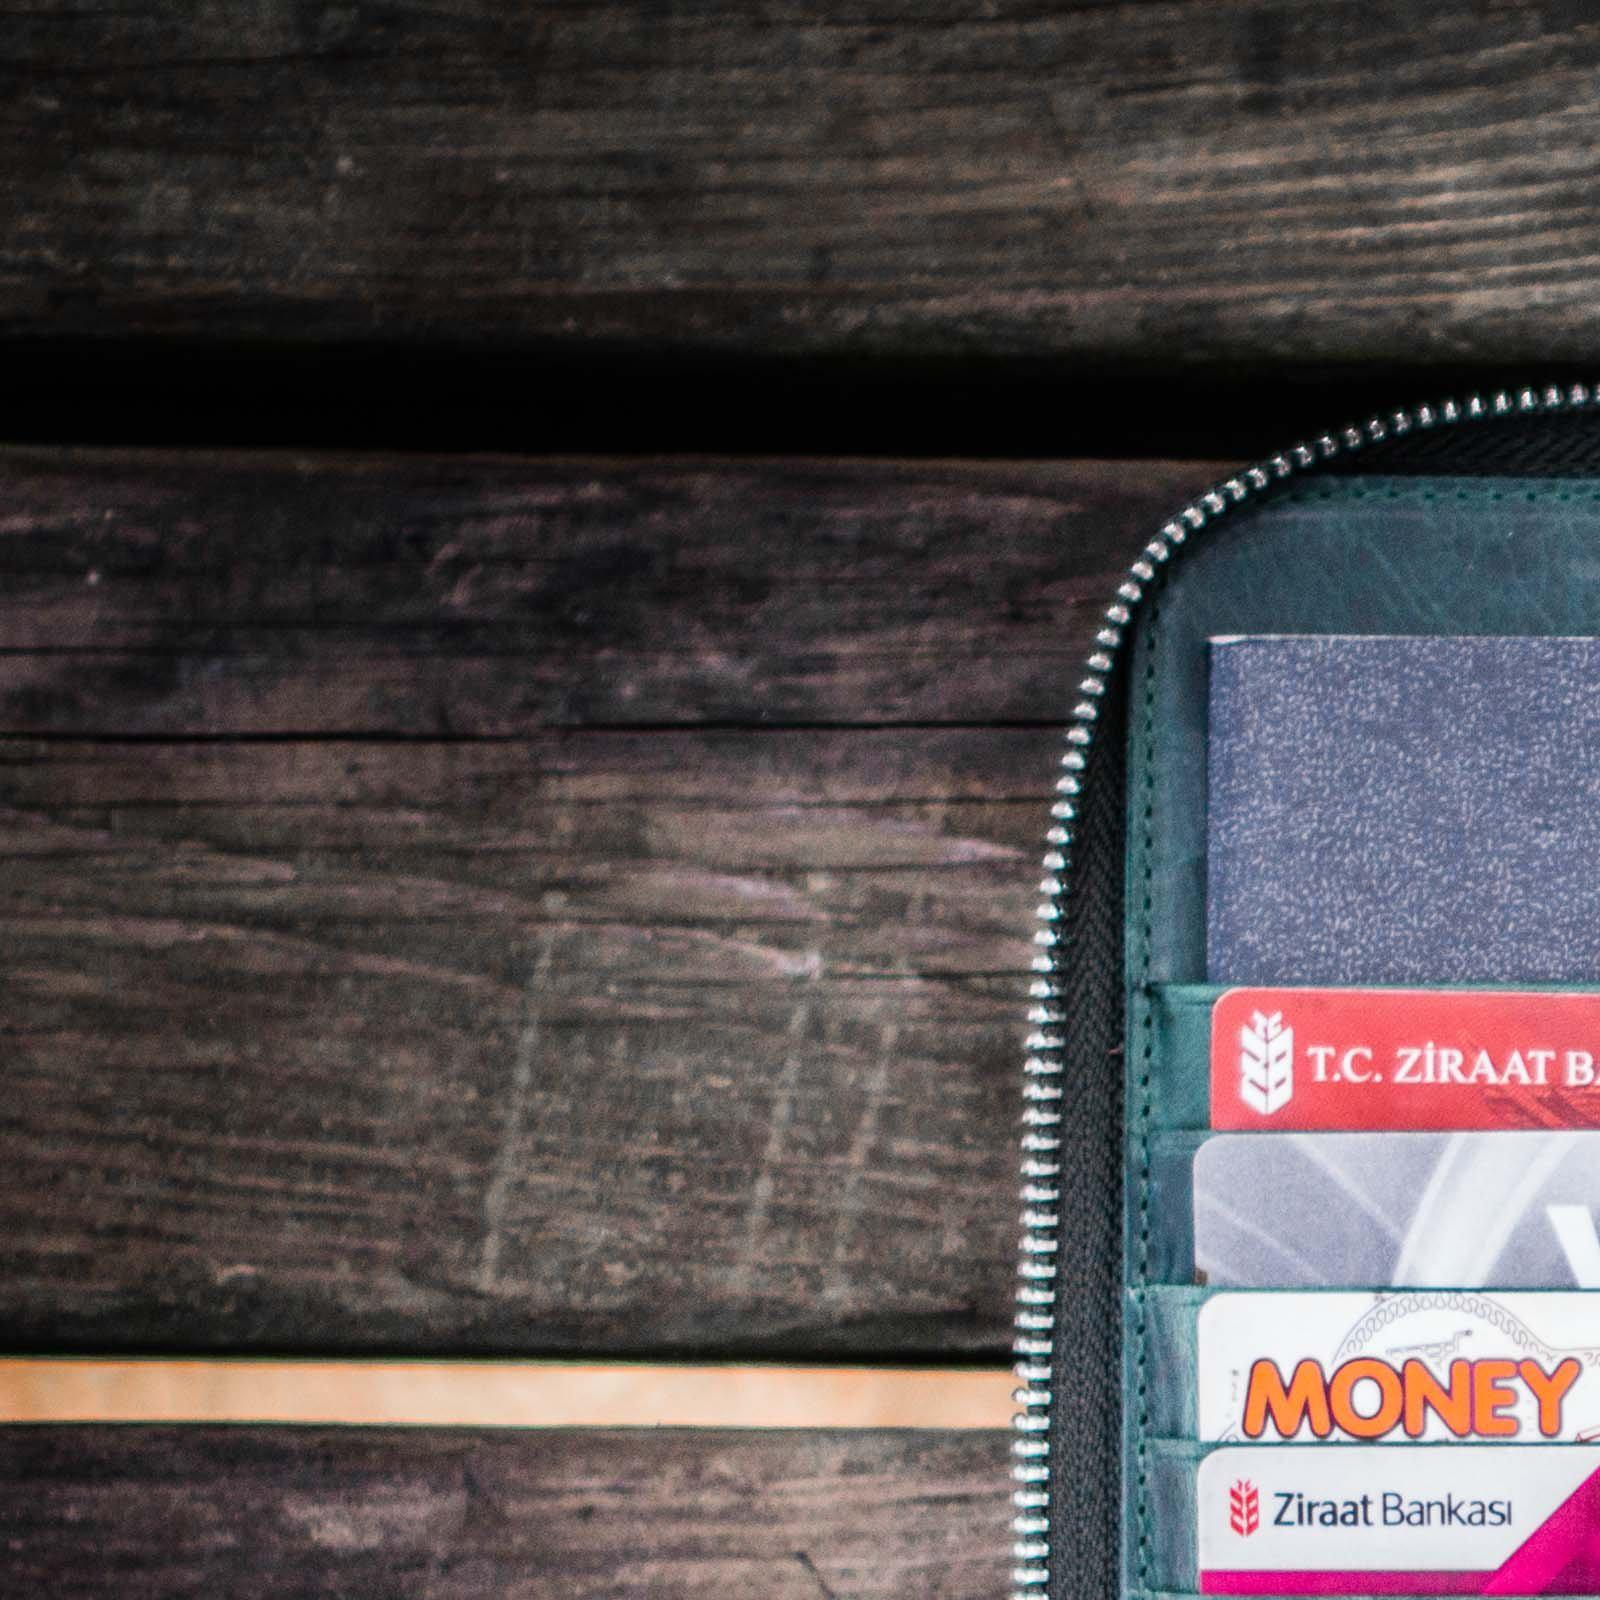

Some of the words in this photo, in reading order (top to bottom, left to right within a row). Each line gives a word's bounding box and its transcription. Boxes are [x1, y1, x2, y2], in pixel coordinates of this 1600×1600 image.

[1307, 1046, 1383, 1083] T.C.
[1393, 1041, 1556, 1087] ZİRAAT
[1241, 1356, 1583, 1438] MONEY
[1273, 1492, 1374, 1527] Ziraat
[1381, 1491, 1512, 1527] Bankası
